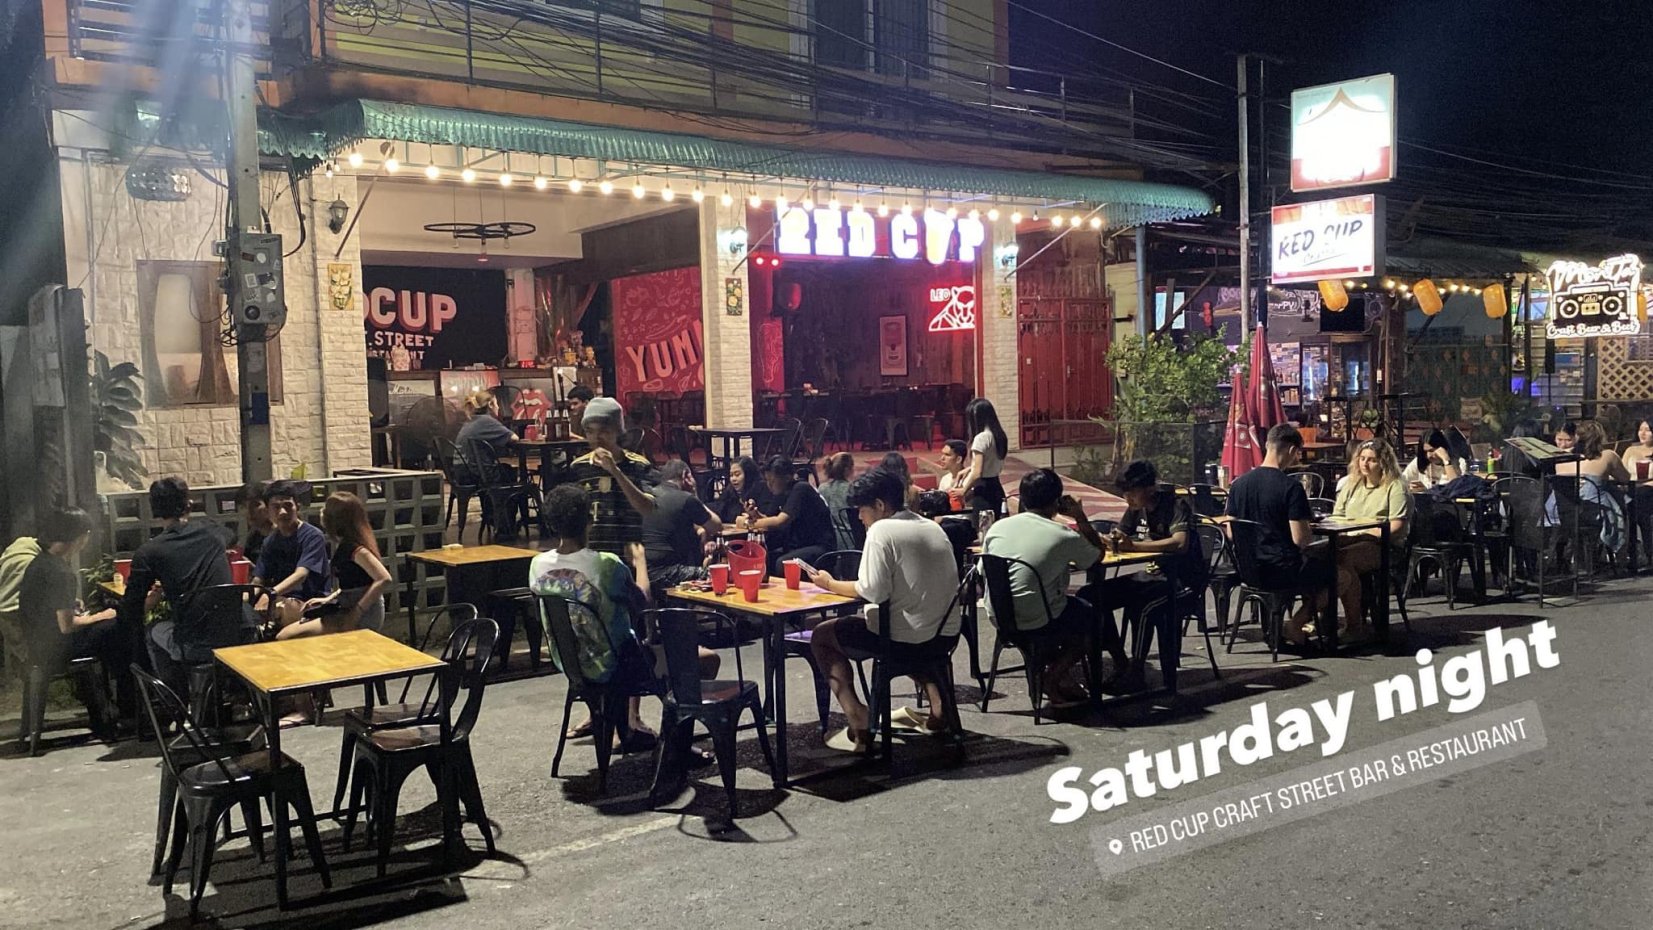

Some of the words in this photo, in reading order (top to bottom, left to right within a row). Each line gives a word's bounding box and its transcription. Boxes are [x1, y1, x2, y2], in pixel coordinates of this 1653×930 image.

[362, 286, 457, 332] CUP
[1547, 325, 1575, 337] Craft
[1577, 323, 1601, 335] Beer
